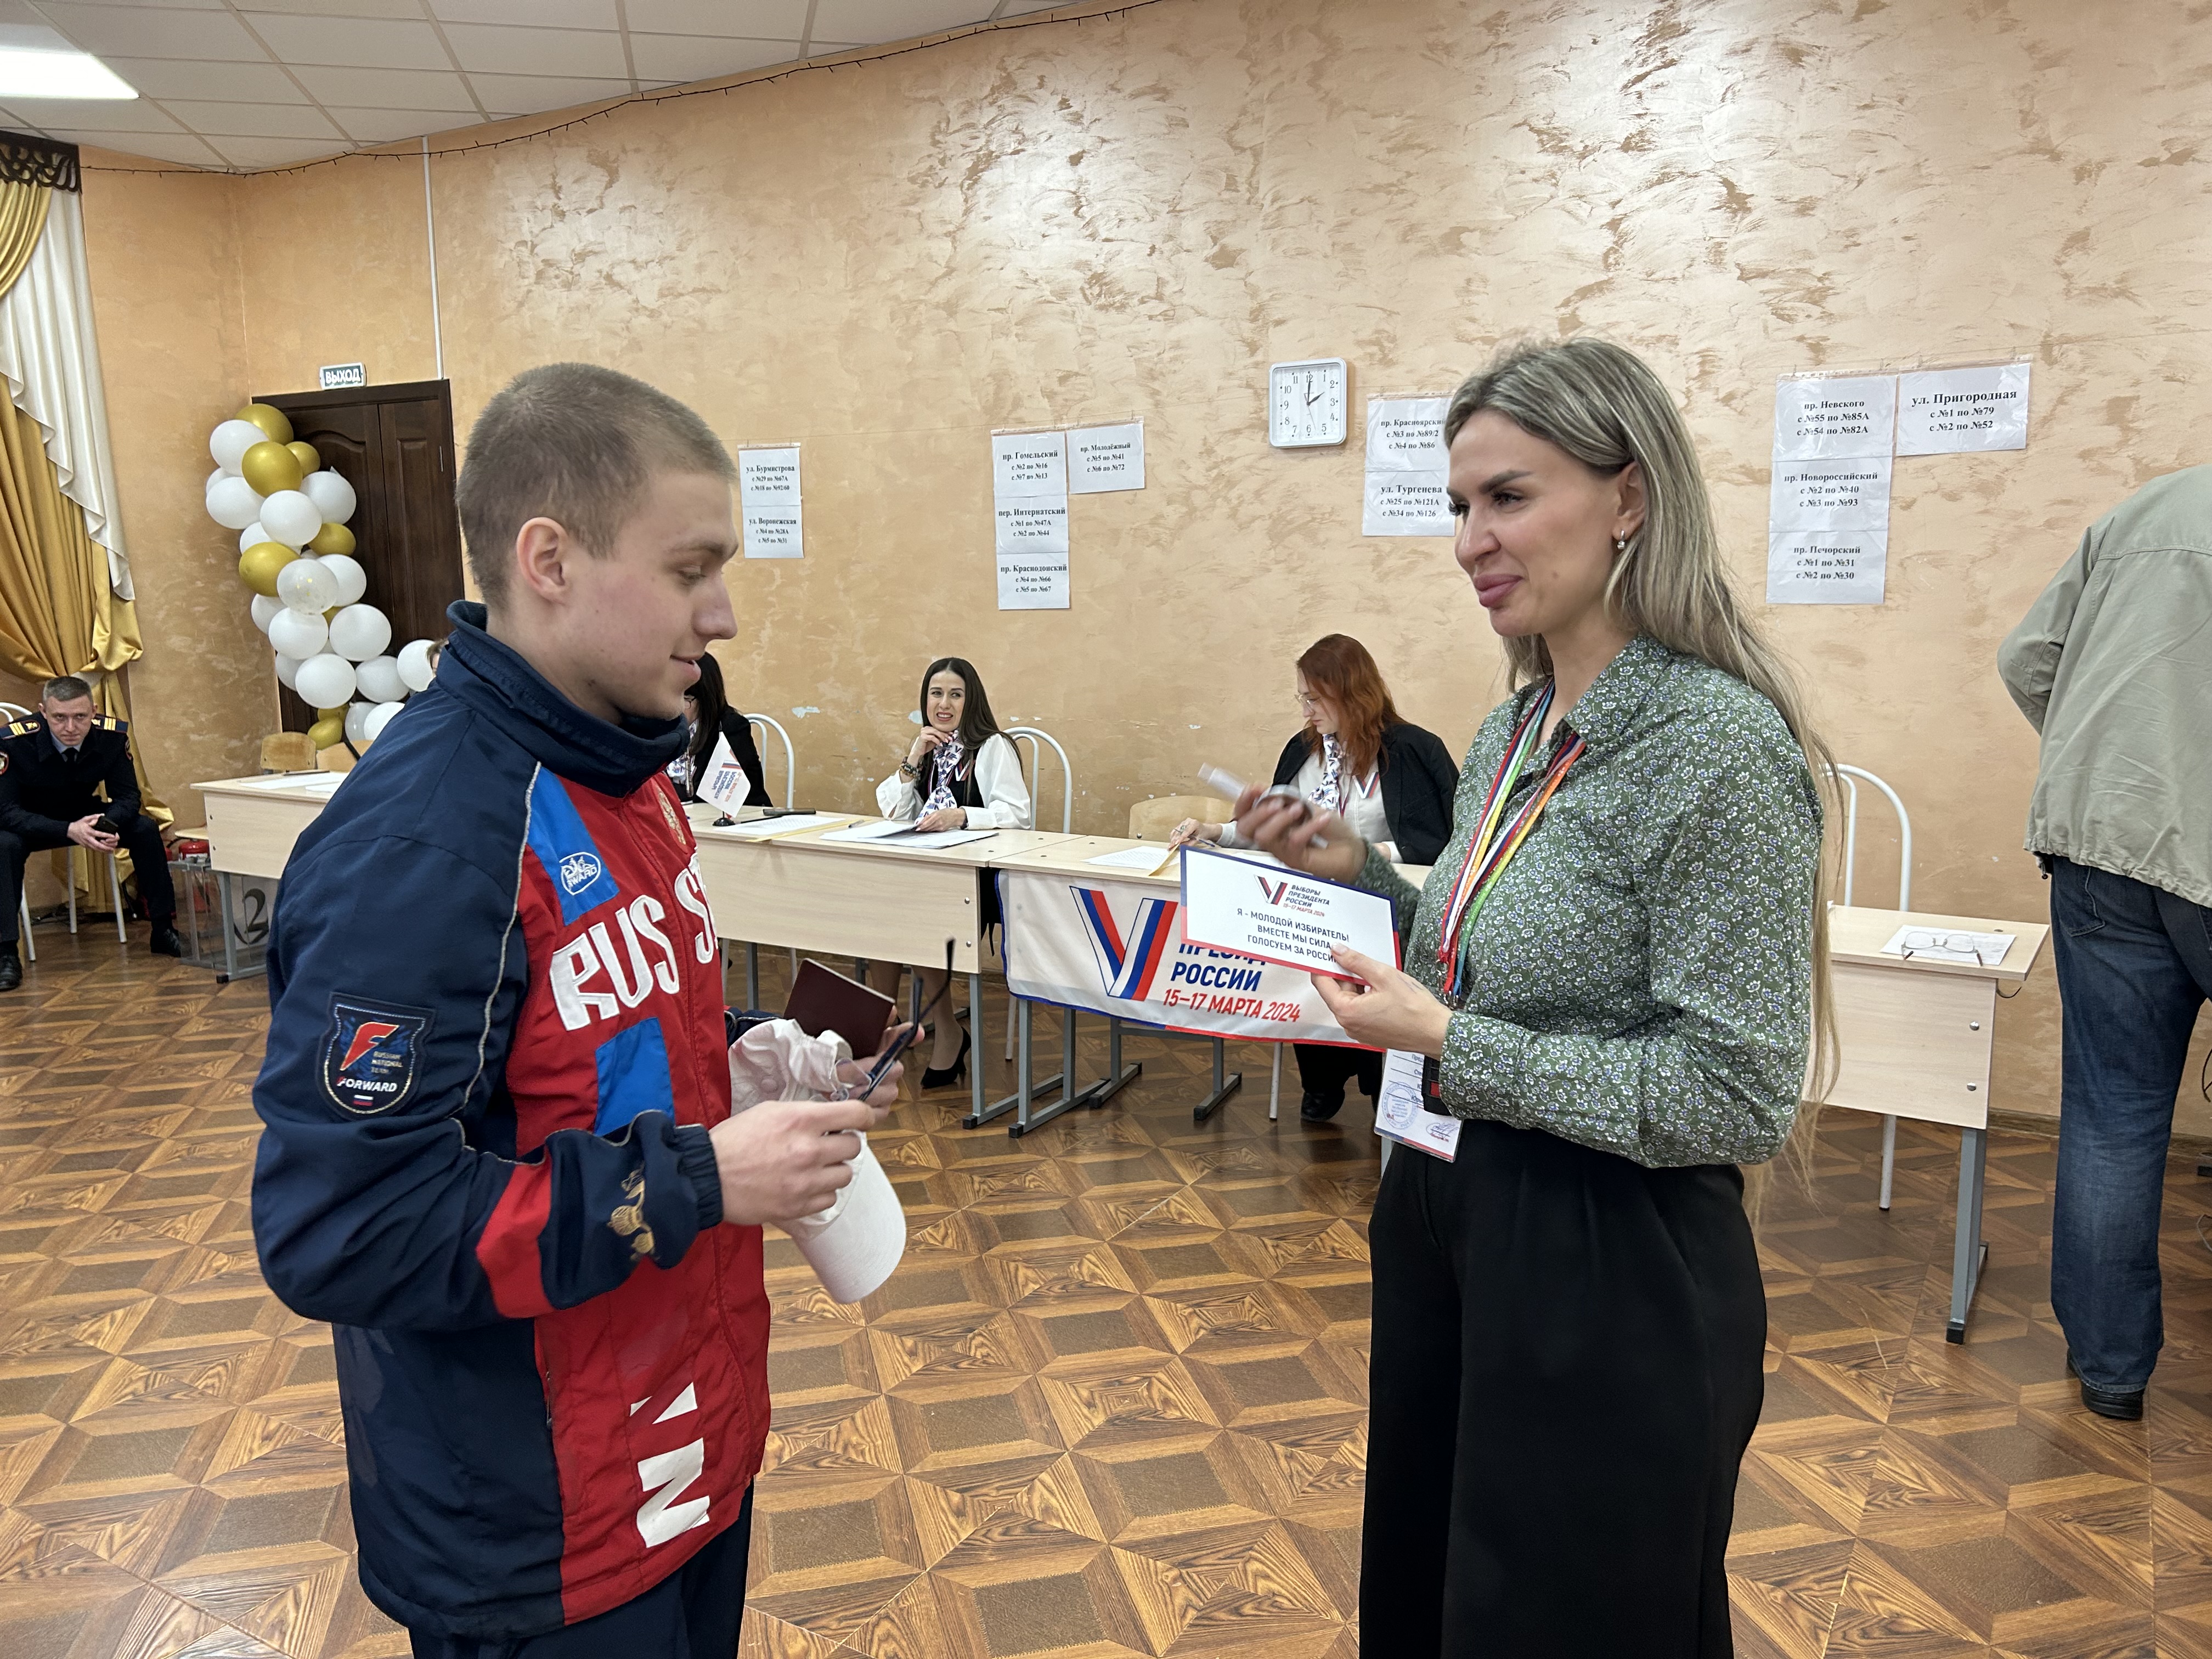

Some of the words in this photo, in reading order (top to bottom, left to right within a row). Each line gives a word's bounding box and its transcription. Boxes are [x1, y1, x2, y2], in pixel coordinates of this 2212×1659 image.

[326, 368, 360, 383] ВЫХОД
[1306, 374, 1313, 383] 12
[1330, 380, 1335, 388] 2
[1912, 397, 1929, 407] ул.
[1933, 391, 2017, 405] Пригородная
[1284, 400, 1289, 410] 9
[1821, 400, 1864, 409] Невского
[1937, 409, 1953, 417] №1
[1971, 407, 1994, 416] №79
[1804, 414, 1825, 422] №55
[1841, 413, 1869, 421] №85А
[1307, 425, 1311, 433] 6
[1803, 427, 1824, 436] №54
[1839, 426, 1868, 434] №82А
[1937, 423, 1953, 431] №2
[1971, 421, 1993, 429] №52
[1091, 442, 1131, 451] Молодёжный
[1015, 450, 1058, 459] Гомельский
[1801, 472, 1877, 482] Новороссийский
[1396, 485, 1442, 495] Тургенева
[1014, 507, 1065, 517] Интернатский
[1810, 546, 1860, 555] Печорский
[1013, 564, 1066, 573] Краснодонский
[1291, 885, 1321, 896] ВЫБОРЫ
[1285, 897, 1312, 907] РОССИИ
[1288, 891, 1329, 905] ПРЕЗИДЕНТА
[243, 888, 269, 934] 2
[1251, 911, 1293, 928] МОЛОДОЙ
[1295, 922, 1349, 941] ИЗБИРАТЕЛЬ!
[1258, 924, 1289, 939] ВМЕСТЕ
[1293, 933, 1307, 943] МЫ
[1248, 934, 1291, 952] ГОЛОСУЕМ
[1294, 946, 1304, 955] ЗА
[1170, 962, 1262, 992] РОССИИ
[1207, 995, 1263, 1018] МАРТА
[1261, 1001, 1300, 1023] 2024
[336, 1076, 397, 1092] FORWARD
